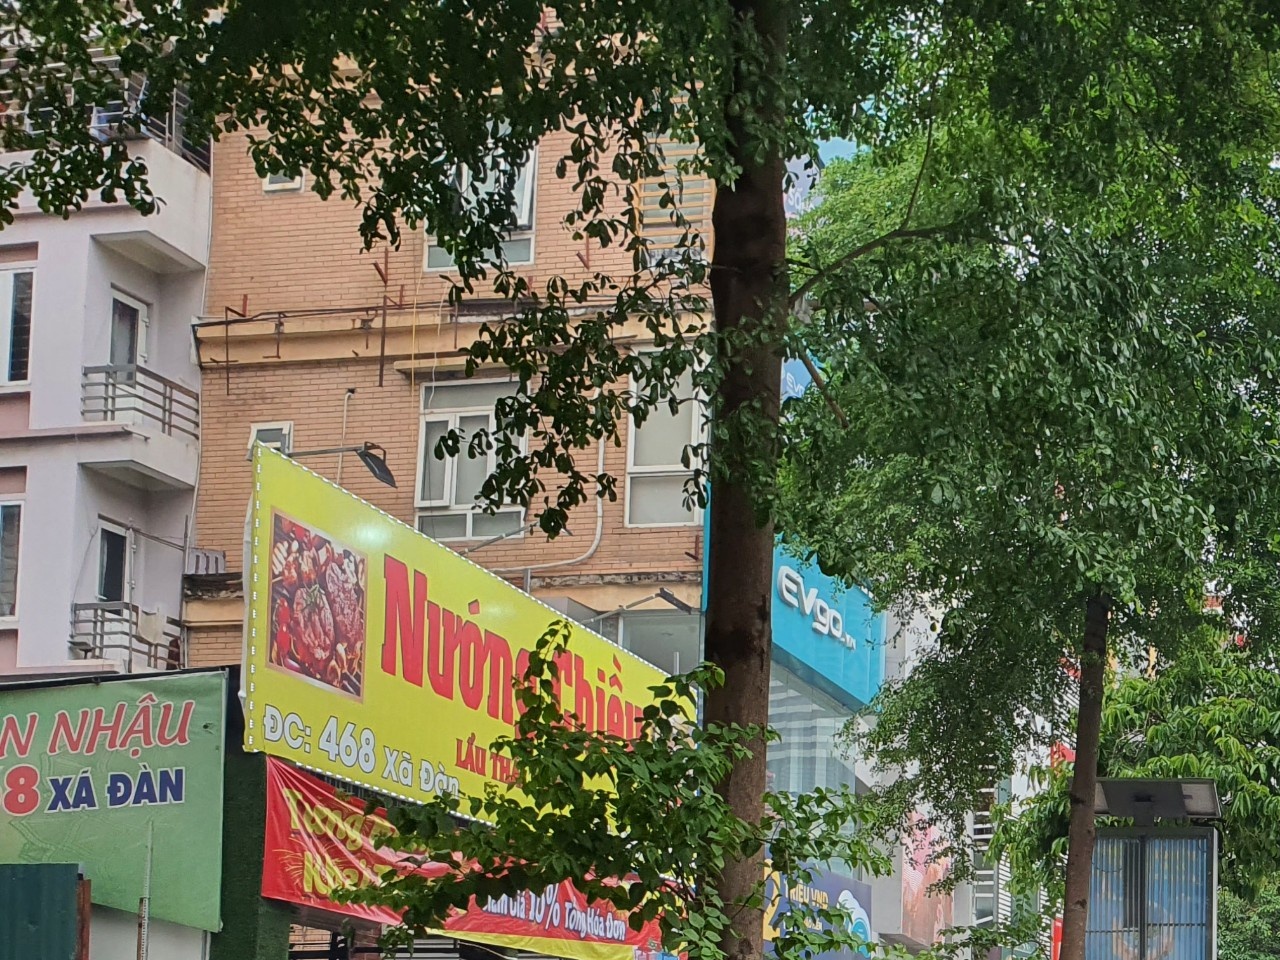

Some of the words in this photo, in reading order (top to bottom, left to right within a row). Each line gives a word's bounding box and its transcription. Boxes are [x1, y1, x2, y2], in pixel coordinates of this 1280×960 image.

[47, 691, 195, 758] NHẬU
[263, 704, 312, 754] ĐC:
[318, 715, 376, 774] 468
[107, 762, 185, 808] ĐÀN
